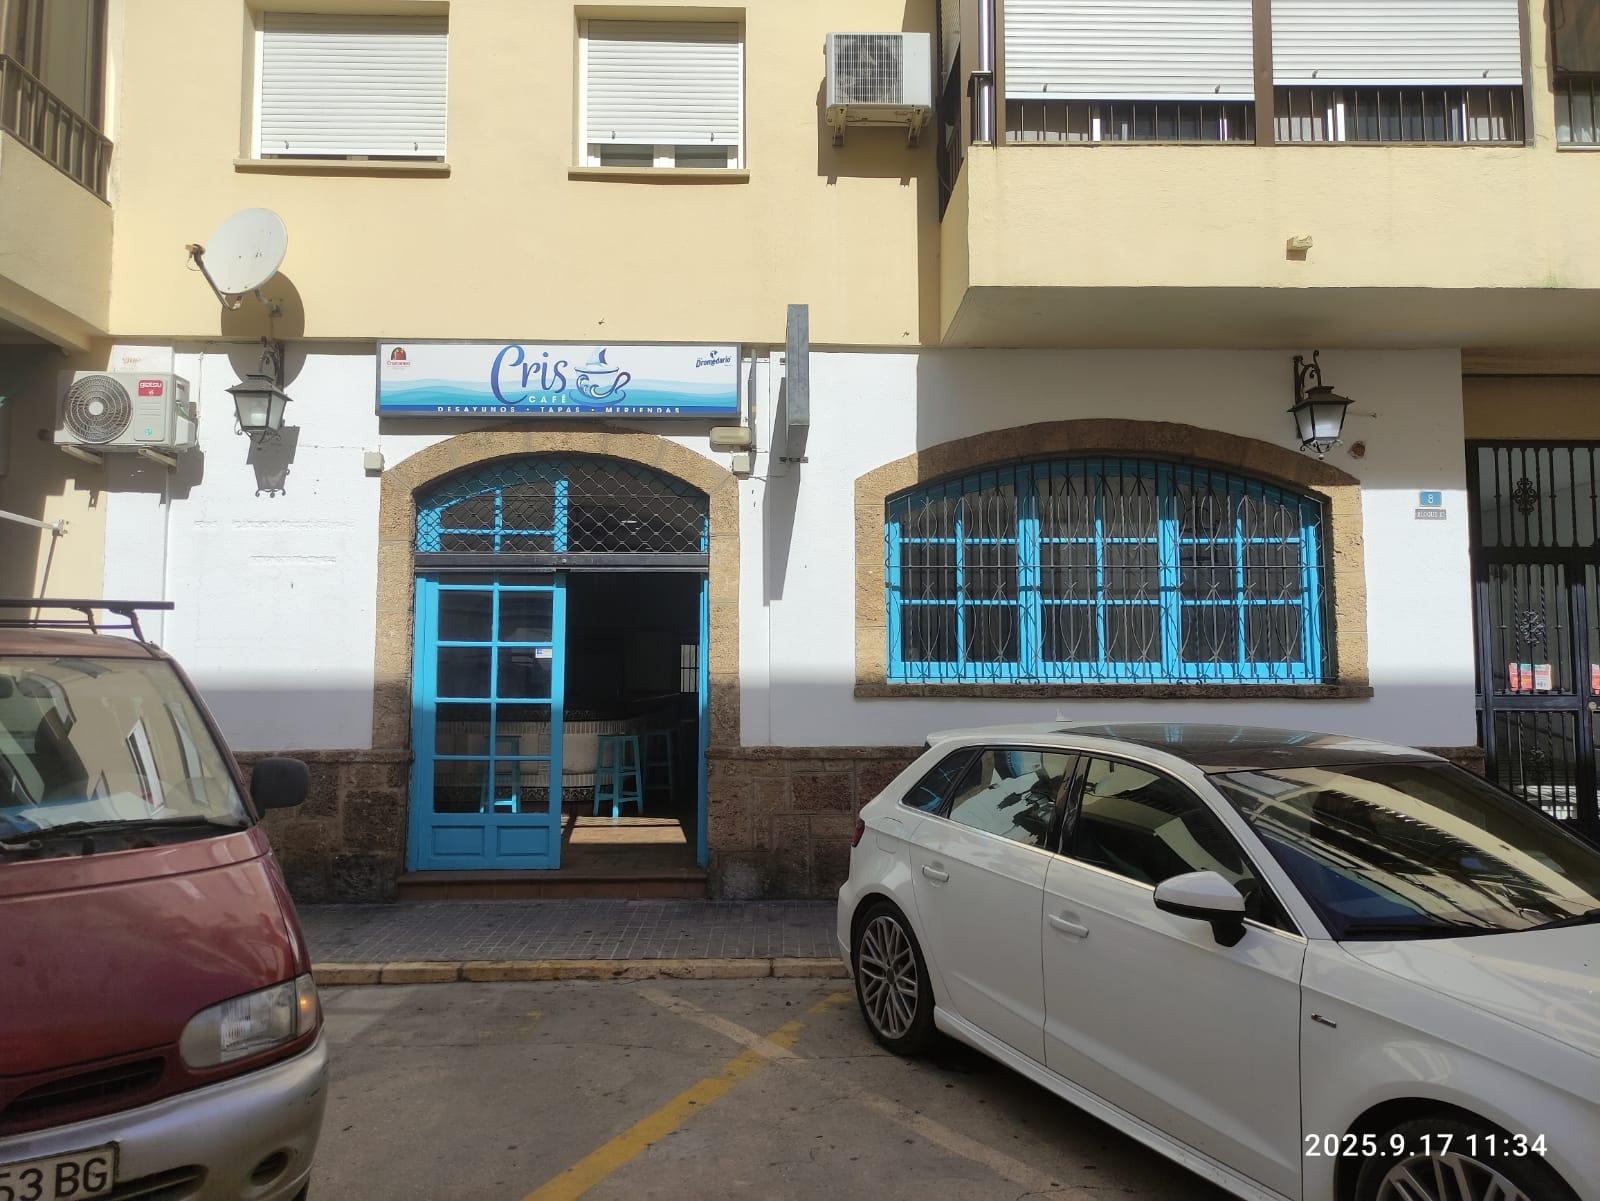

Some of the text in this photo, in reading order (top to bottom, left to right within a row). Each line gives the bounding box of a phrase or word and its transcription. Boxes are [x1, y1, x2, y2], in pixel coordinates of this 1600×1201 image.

[490, 344, 568, 405] Cris
[695, 356, 731, 368] Dromedario
[528, 394, 566, 404] CAFÉ
[55, 1157, 108, 1198] BG
